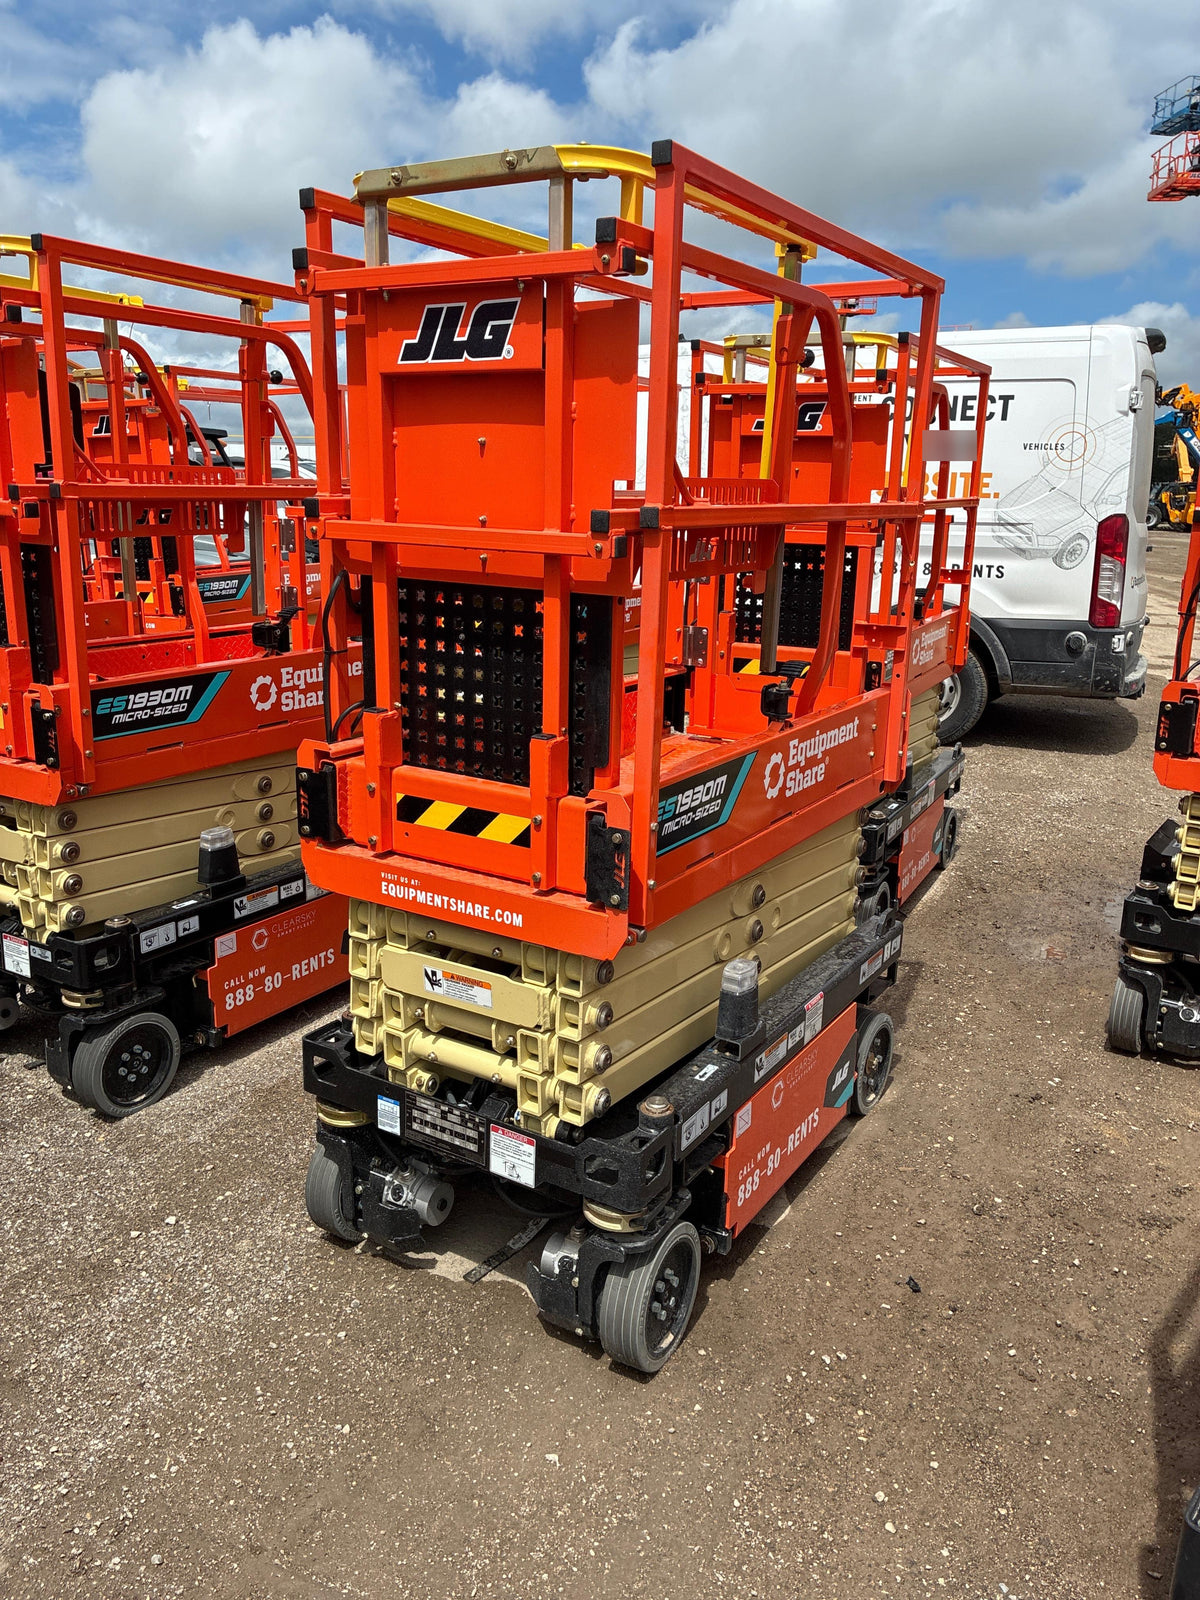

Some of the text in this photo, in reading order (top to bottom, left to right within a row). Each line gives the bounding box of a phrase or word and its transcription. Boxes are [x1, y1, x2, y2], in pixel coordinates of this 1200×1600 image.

[397, 297, 521, 364] JLG
[1022, 442, 1065, 451] VEHICLES
[96, 685, 193, 715] ES1930M
[112, 703, 188, 725] MICRO-SIZED
[787, 716, 860, 767] Equipment
[658, 774, 728, 821] ES1930M
[785, 761, 826, 798] Share
[661, 799, 722, 837] MICRO-SIZED
[380, 871, 421, 886] VISIT US AT:
[271, 910, 317, 934] CLEARSKY
[381, 881, 523, 928] EQUIPMENTSHARE.COM
[224, 965, 266, 990] CALL NOW
[225, 948, 335, 1011] 888-80-RENTS
[832, 1060, 850, 1092] JLG
[737, 1107, 819, 1208] 888-80-RENTS
[738, 1141, 771, 1181] CALL NOW
